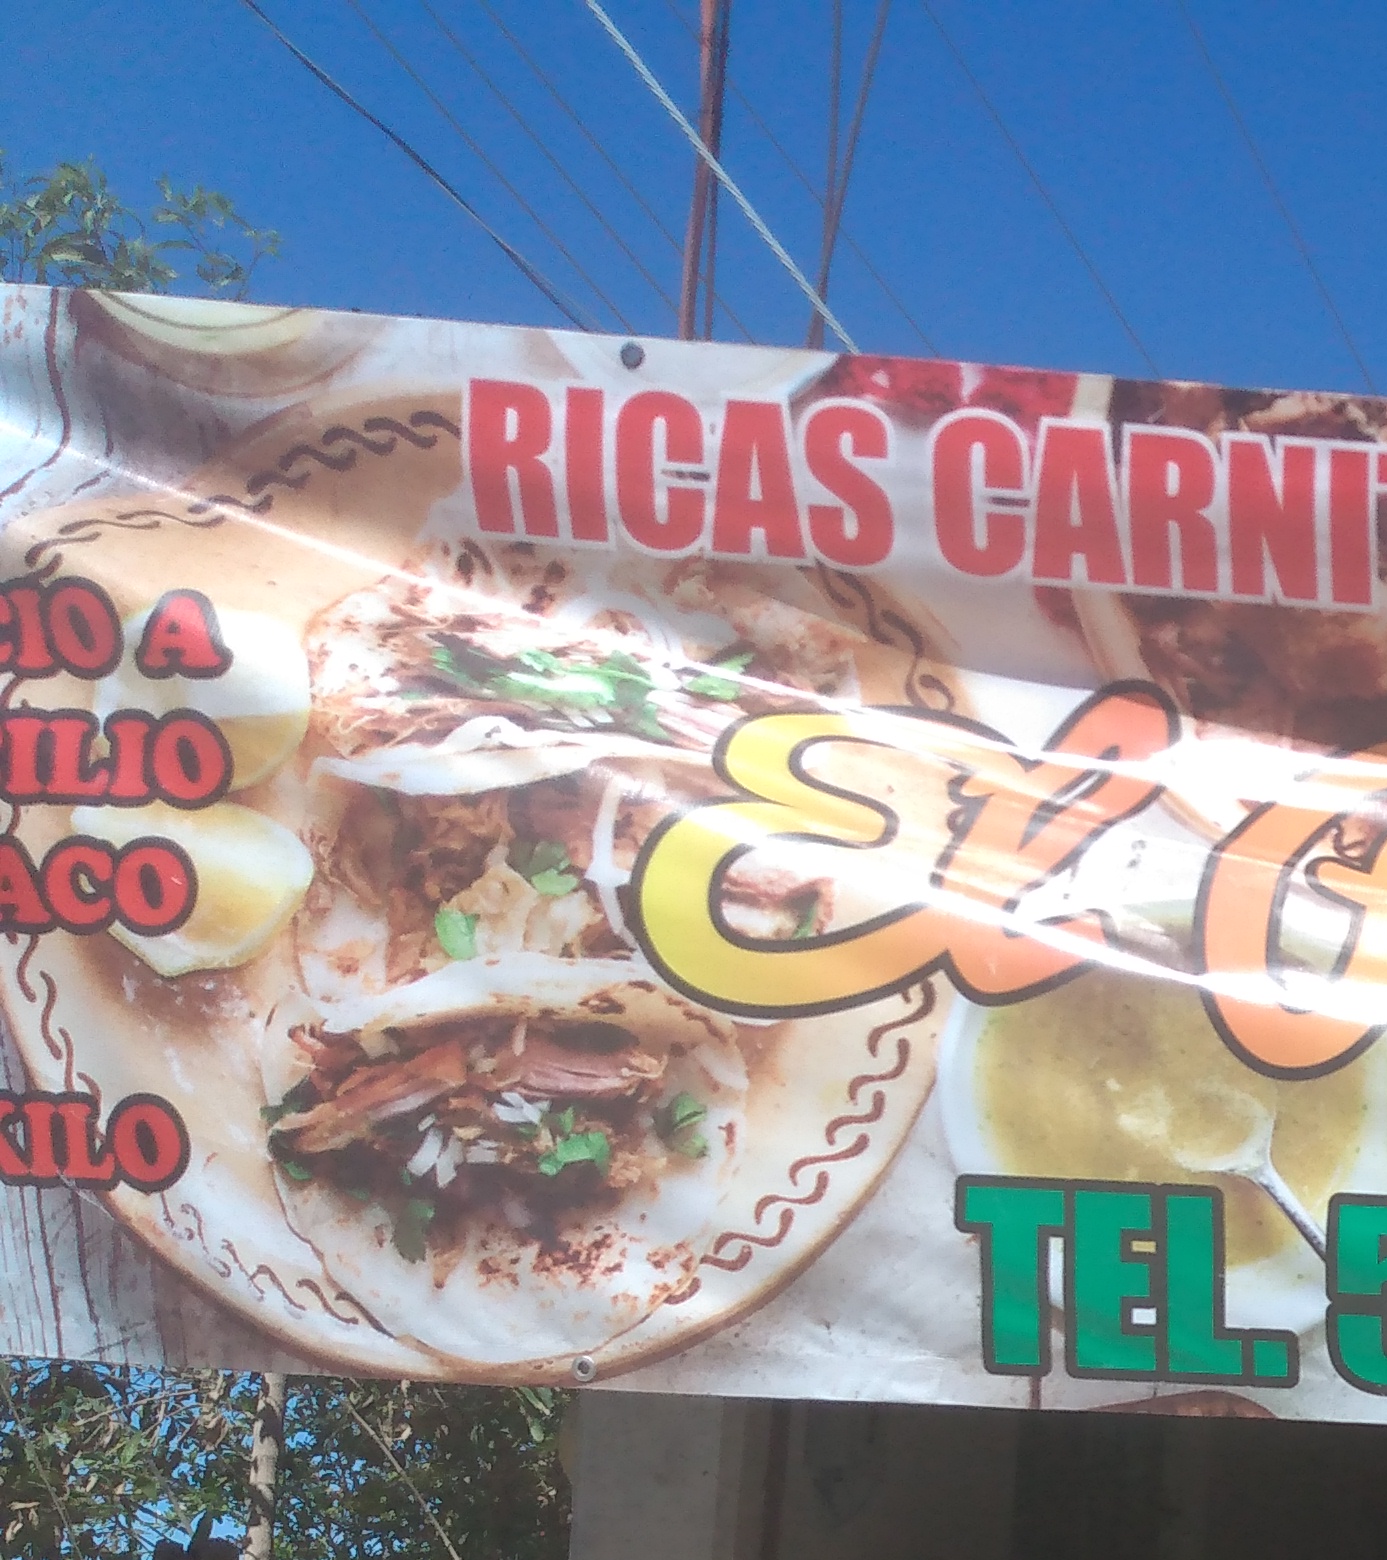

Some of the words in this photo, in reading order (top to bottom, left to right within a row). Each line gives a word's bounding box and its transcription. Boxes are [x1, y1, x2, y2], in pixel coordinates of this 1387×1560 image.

[466, 376, 897, 569] RICAS
[141, 590, 224, 672] A
[0, 713, 227, 802] ILIO
[633, 681, 1180, 1018] El
[958, 1179, 1296, 1384] TEL.
